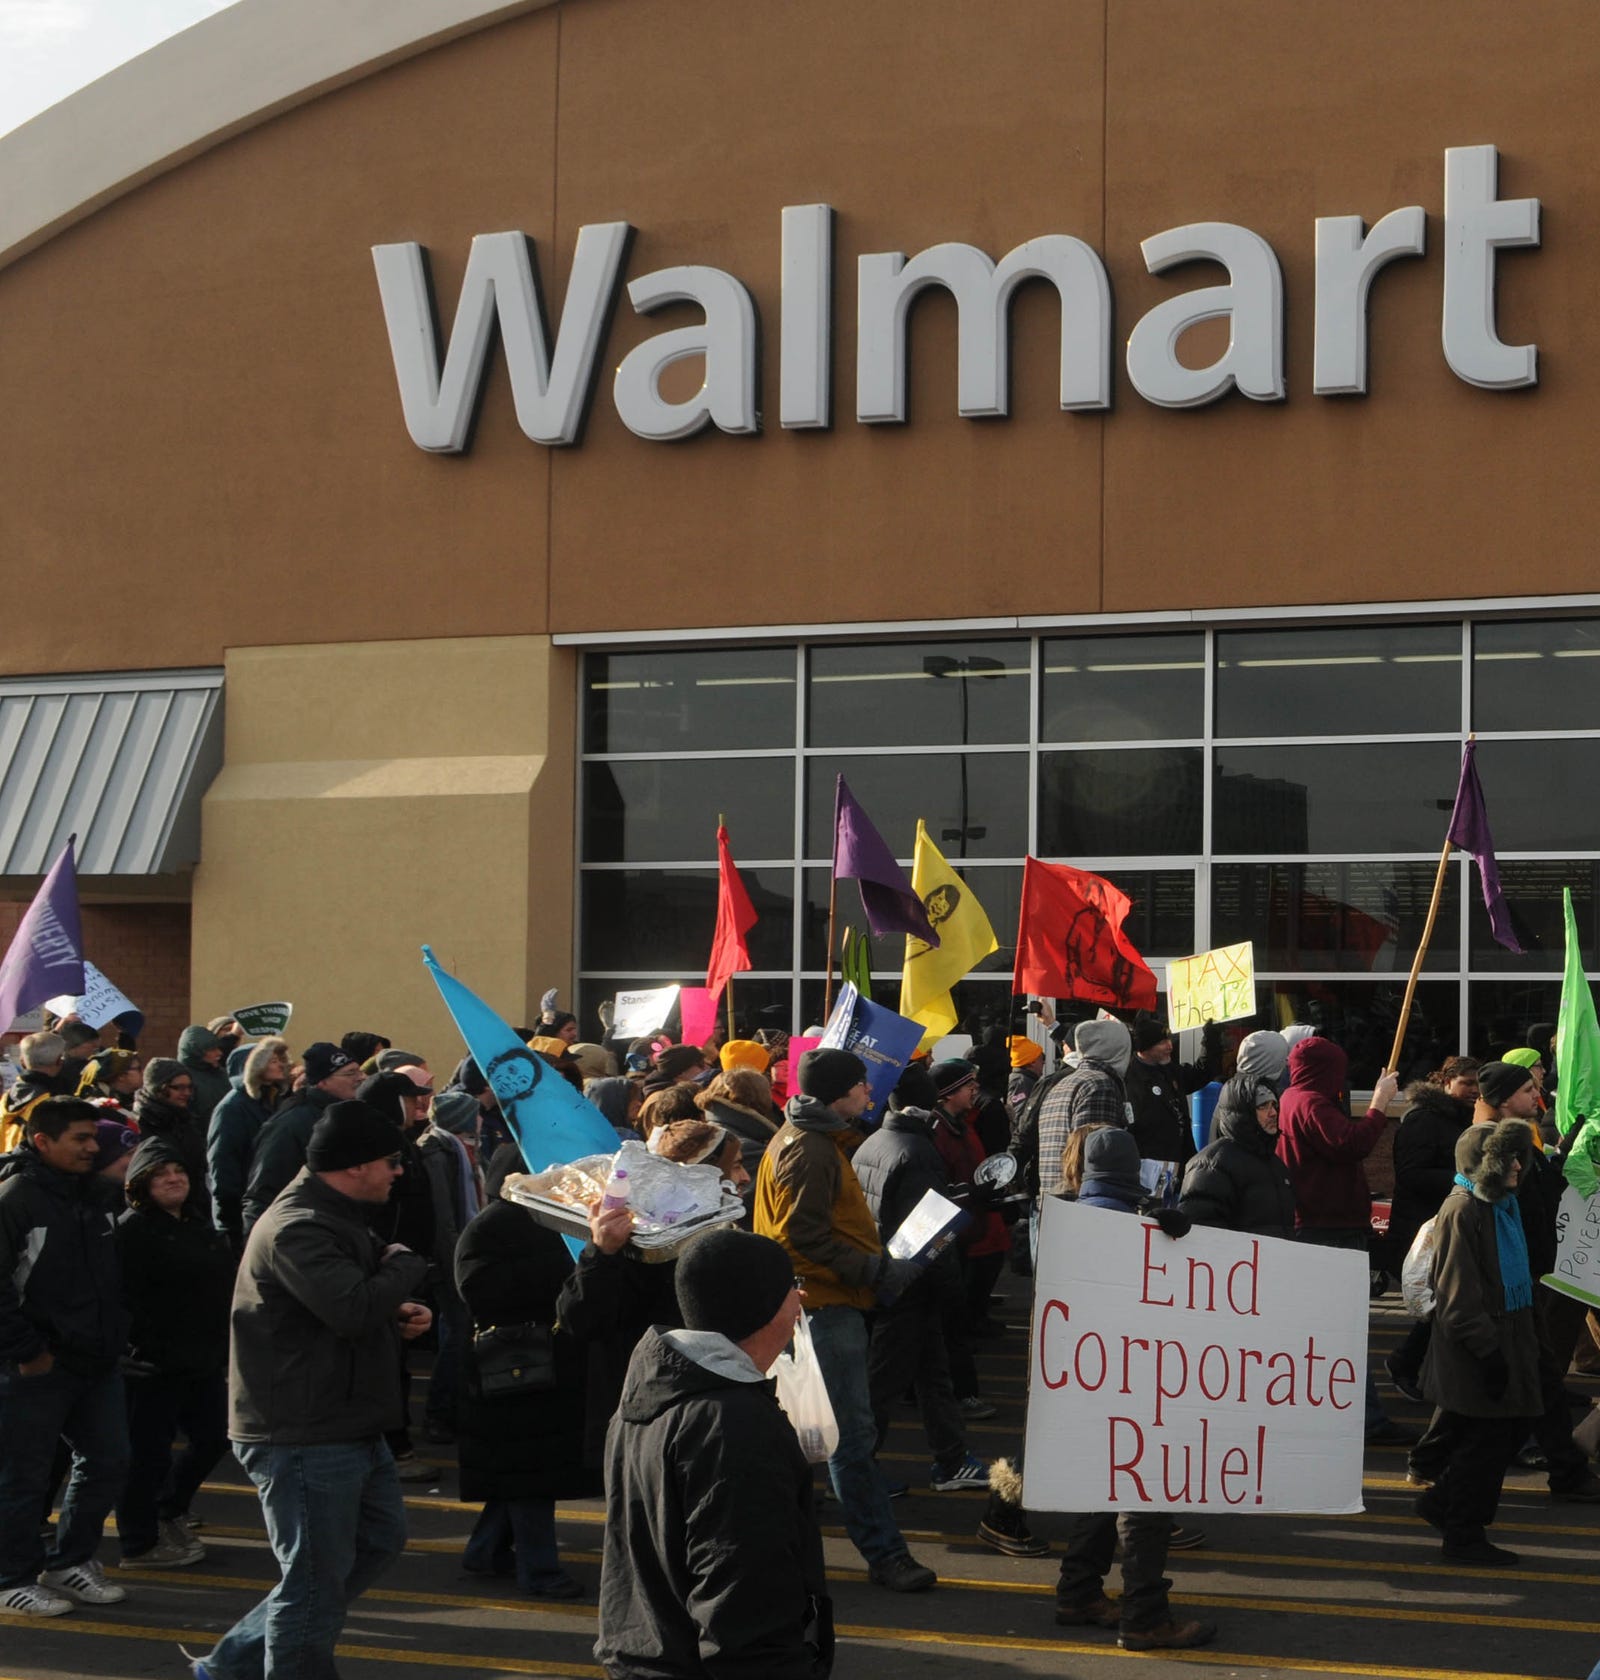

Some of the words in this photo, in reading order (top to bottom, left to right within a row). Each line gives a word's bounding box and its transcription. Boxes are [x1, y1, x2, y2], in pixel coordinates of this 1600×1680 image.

[371, 143, 1540, 454] Walmart
[1174, 994, 1215, 1027] the
[1220, 978, 1250, 1020] 1%
[1178, 945, 1248, 990] TAX
[1139, 1223, 1260, 1316] End
[1040, 1299, 1356, 1426] Corporate
[1108, 1416, 1266, 1505] Rule!
